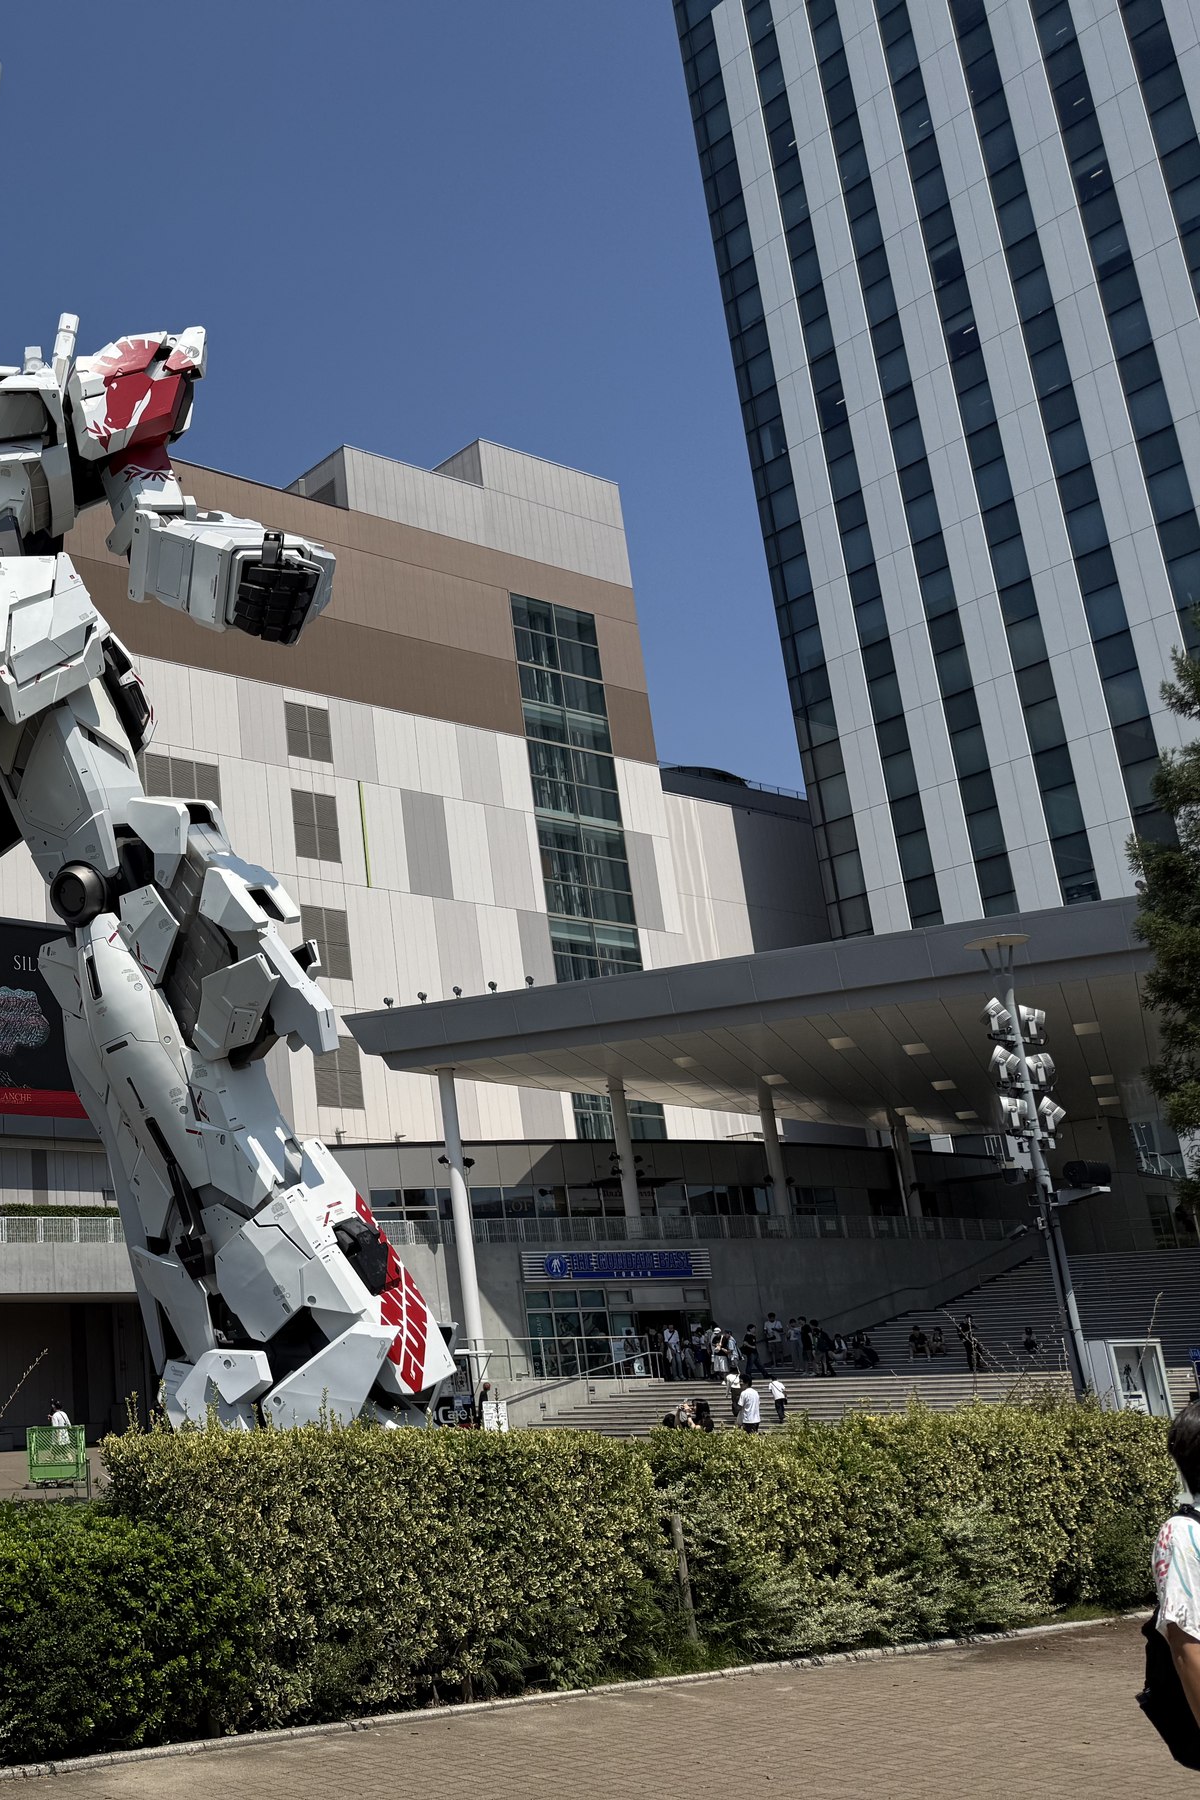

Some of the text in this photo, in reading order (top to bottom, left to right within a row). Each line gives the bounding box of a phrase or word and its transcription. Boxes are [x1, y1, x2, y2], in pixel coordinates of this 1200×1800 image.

[13, 954, 39, 972] SIL
[569, 1251, 692, 1271] THE GUNDAM BASE
